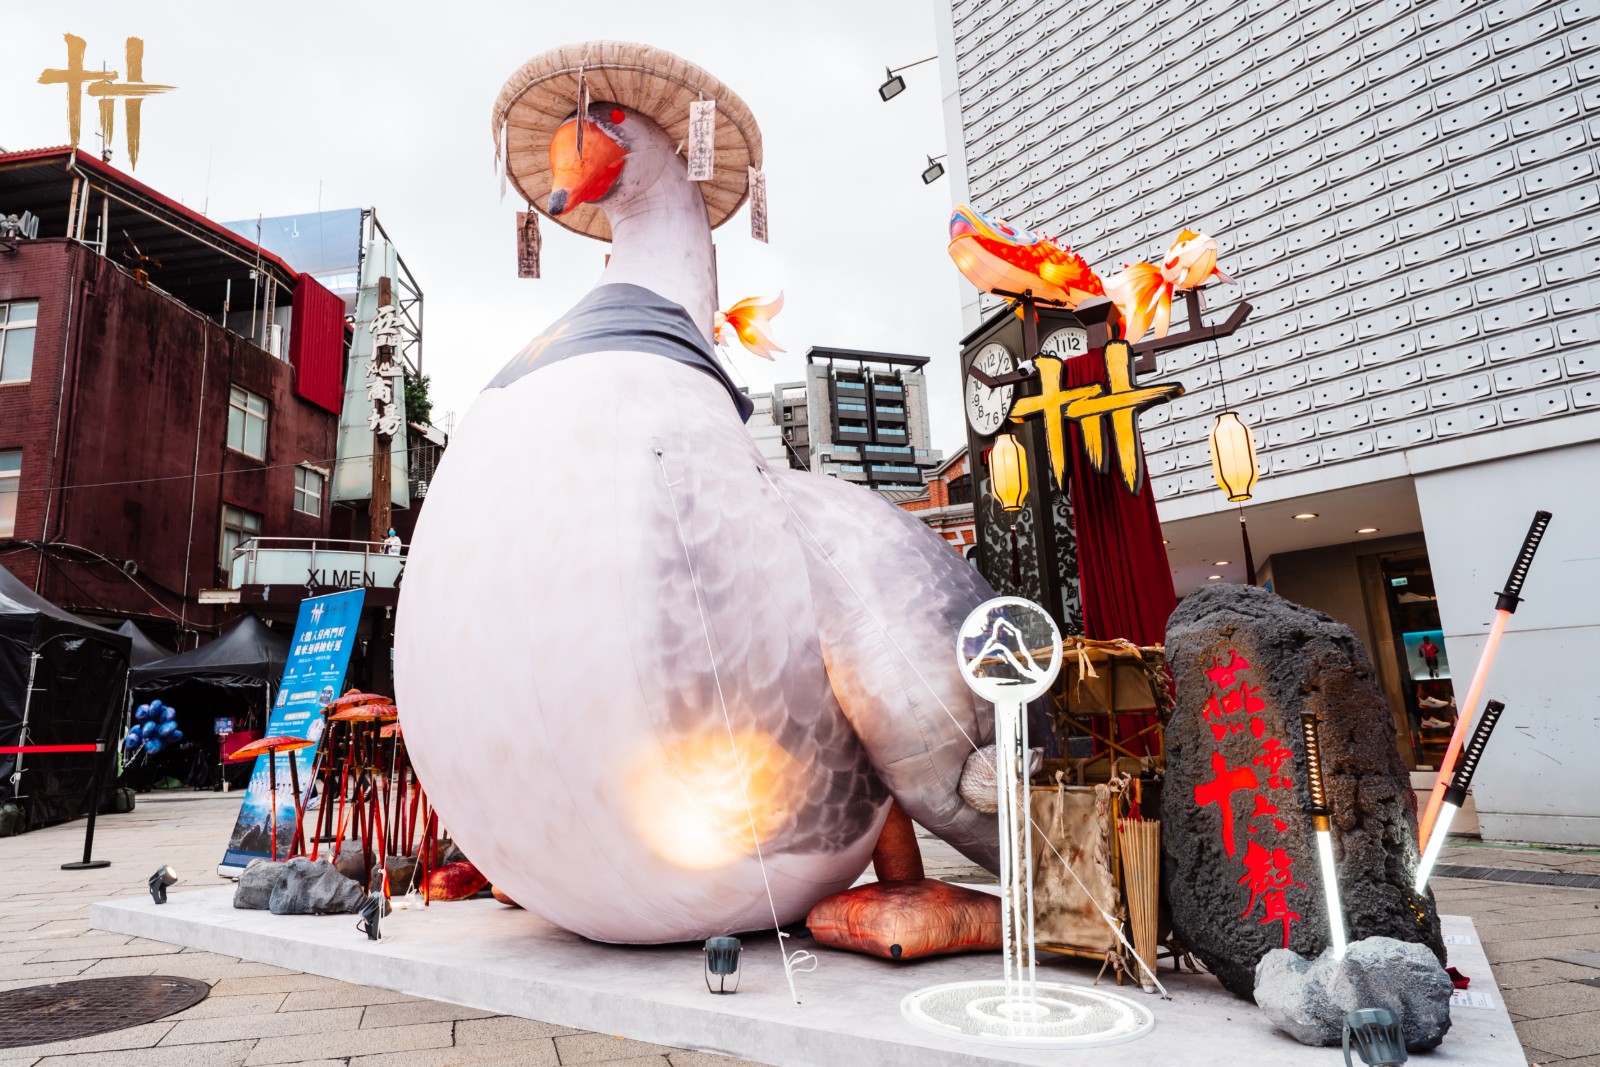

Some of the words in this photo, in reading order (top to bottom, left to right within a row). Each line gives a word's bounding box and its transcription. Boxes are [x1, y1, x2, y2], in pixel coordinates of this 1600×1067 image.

[1056, 339, 1066, 353] 11
[1068, 337, 1081, 351] 12
[987, 354, 995, 368] 12
[1003, 357, 1010, 371] 2
[366, 376, 402, 436] 商場
[974, 394, 980, 407] 9
[978, 405, 984, 418] 8
[1001, 403, 1008, 417] 5
[985, 413, 991, 426] 7
[993, 412, 999, 425] 6
[333, 569, 375, 587] MEN
